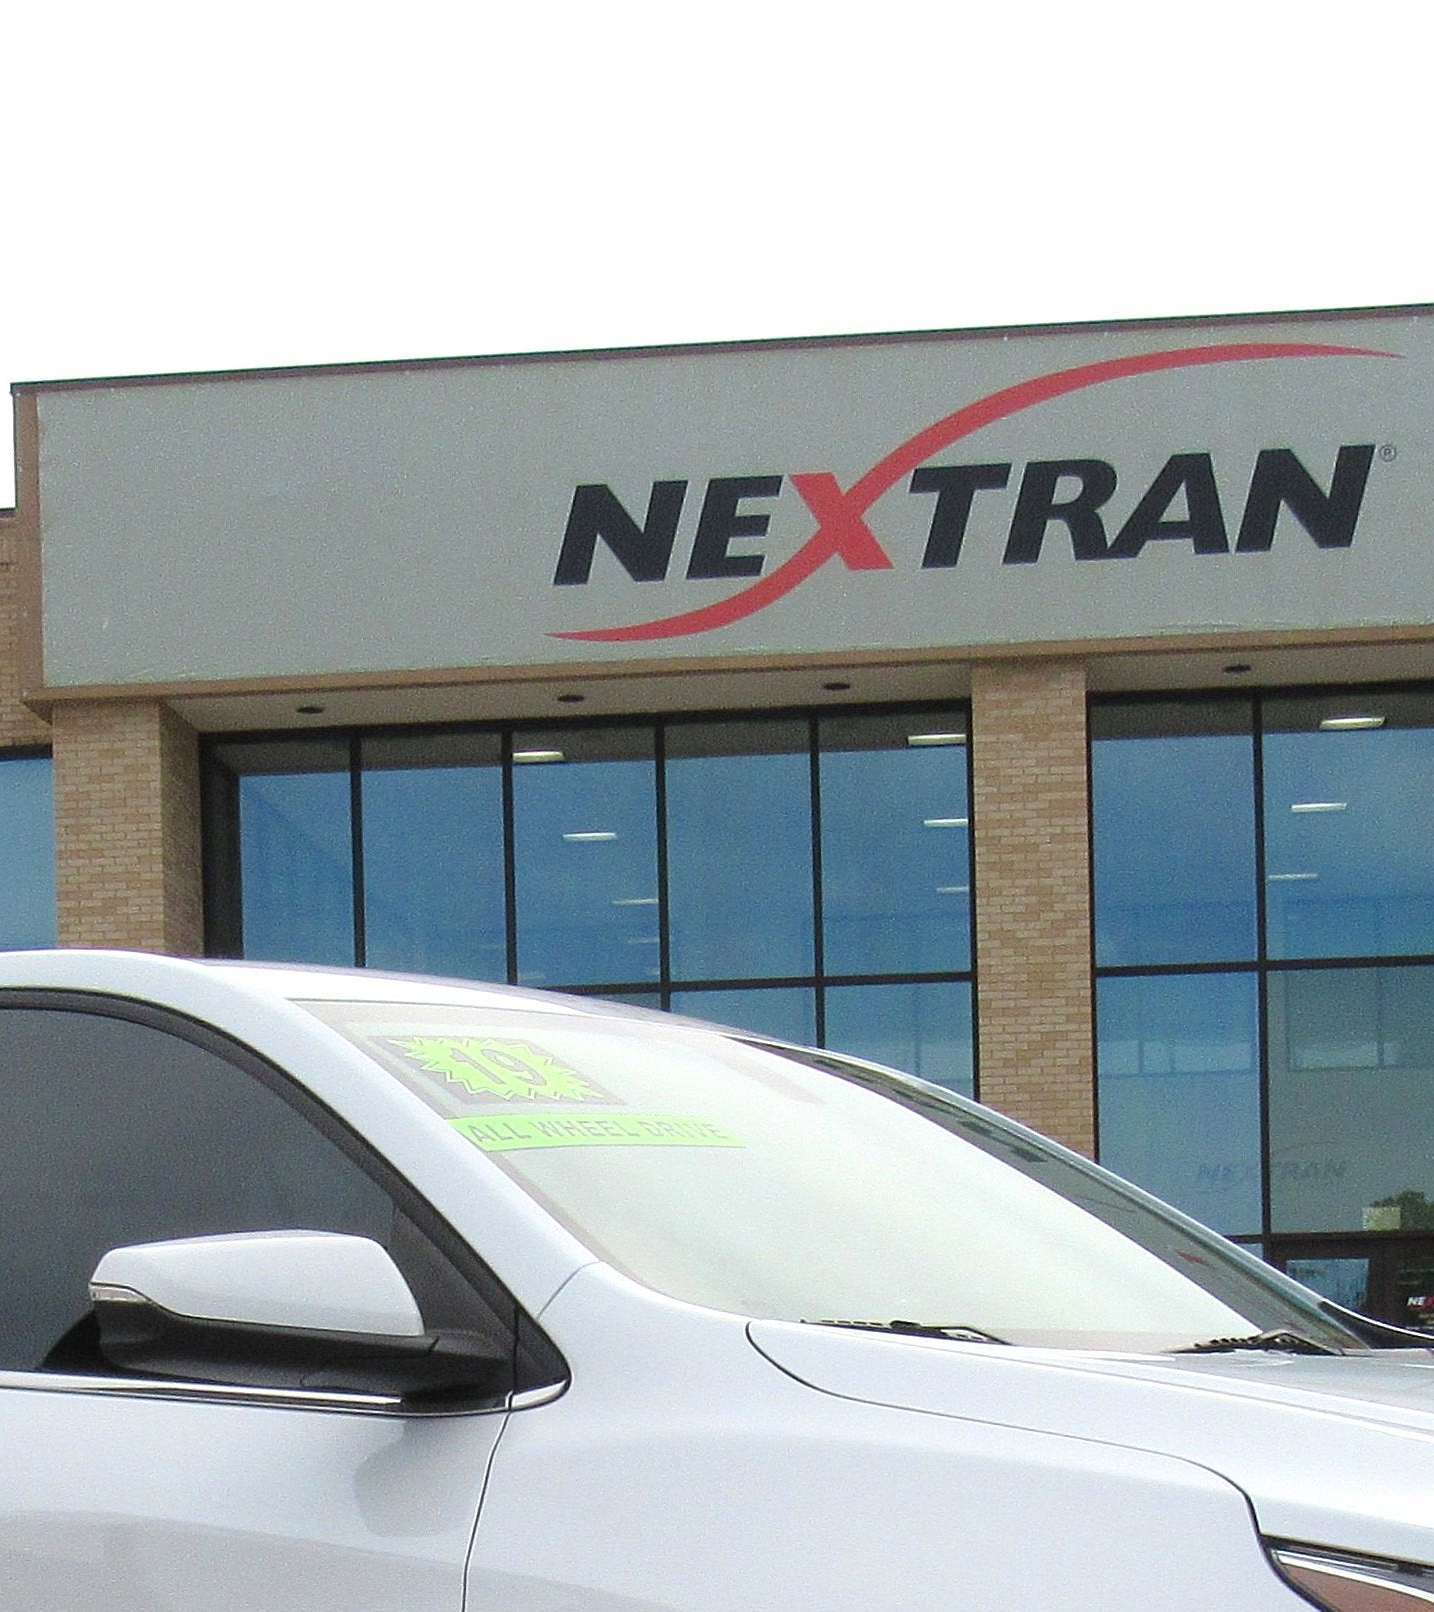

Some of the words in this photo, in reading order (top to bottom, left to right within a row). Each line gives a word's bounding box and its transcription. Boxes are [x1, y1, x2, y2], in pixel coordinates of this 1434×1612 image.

[552, 443, 1378, 586] NEXTRAN
[467, 1122, 533, 1144] ALL
[530, 1120, 640, 1139] WHEEL
[639, 1120, 729, 1140] DRIVE
